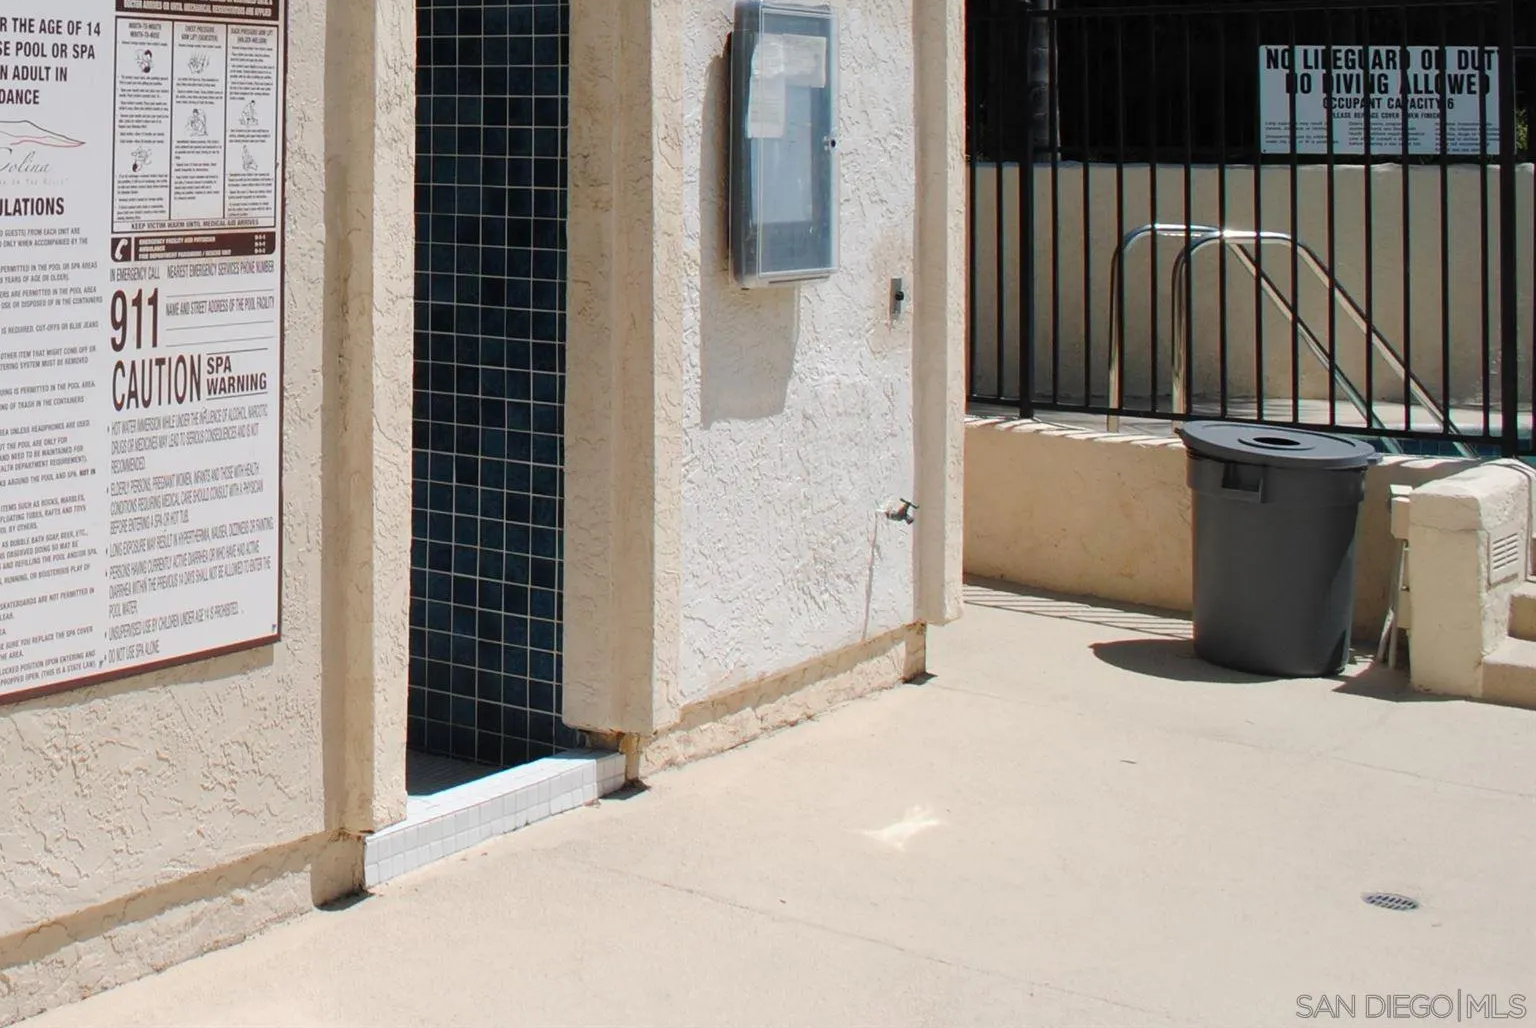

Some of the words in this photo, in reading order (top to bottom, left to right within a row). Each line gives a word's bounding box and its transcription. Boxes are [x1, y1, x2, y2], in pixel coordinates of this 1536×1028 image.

[11, 17, 34, 33] THE
[39, 18, 62, 34] AGE
[67, 20, 81, 35] OF
[87, 22, 100, 36] 14
[15, 41, 47, 57] POOL
[52, 43, 67, 58] OR
[72, 44, 94, 59] SPA
[1266, 48, 1291, 70] NO
[1457, 48, 1500, 71] DUT
[12, 65, 50, 81] ADULT
[55, 67, 67, 81] IN
[1387, 98, 1441, 110] CAACITY
[1447, 99, 1454, 110] 6
[110, 287, 157, 352] 911
[207, 355, 231, 374] SPA
[112, 354, 200, 411] CAUTION
[206, 372, 266, 395] WARNING
